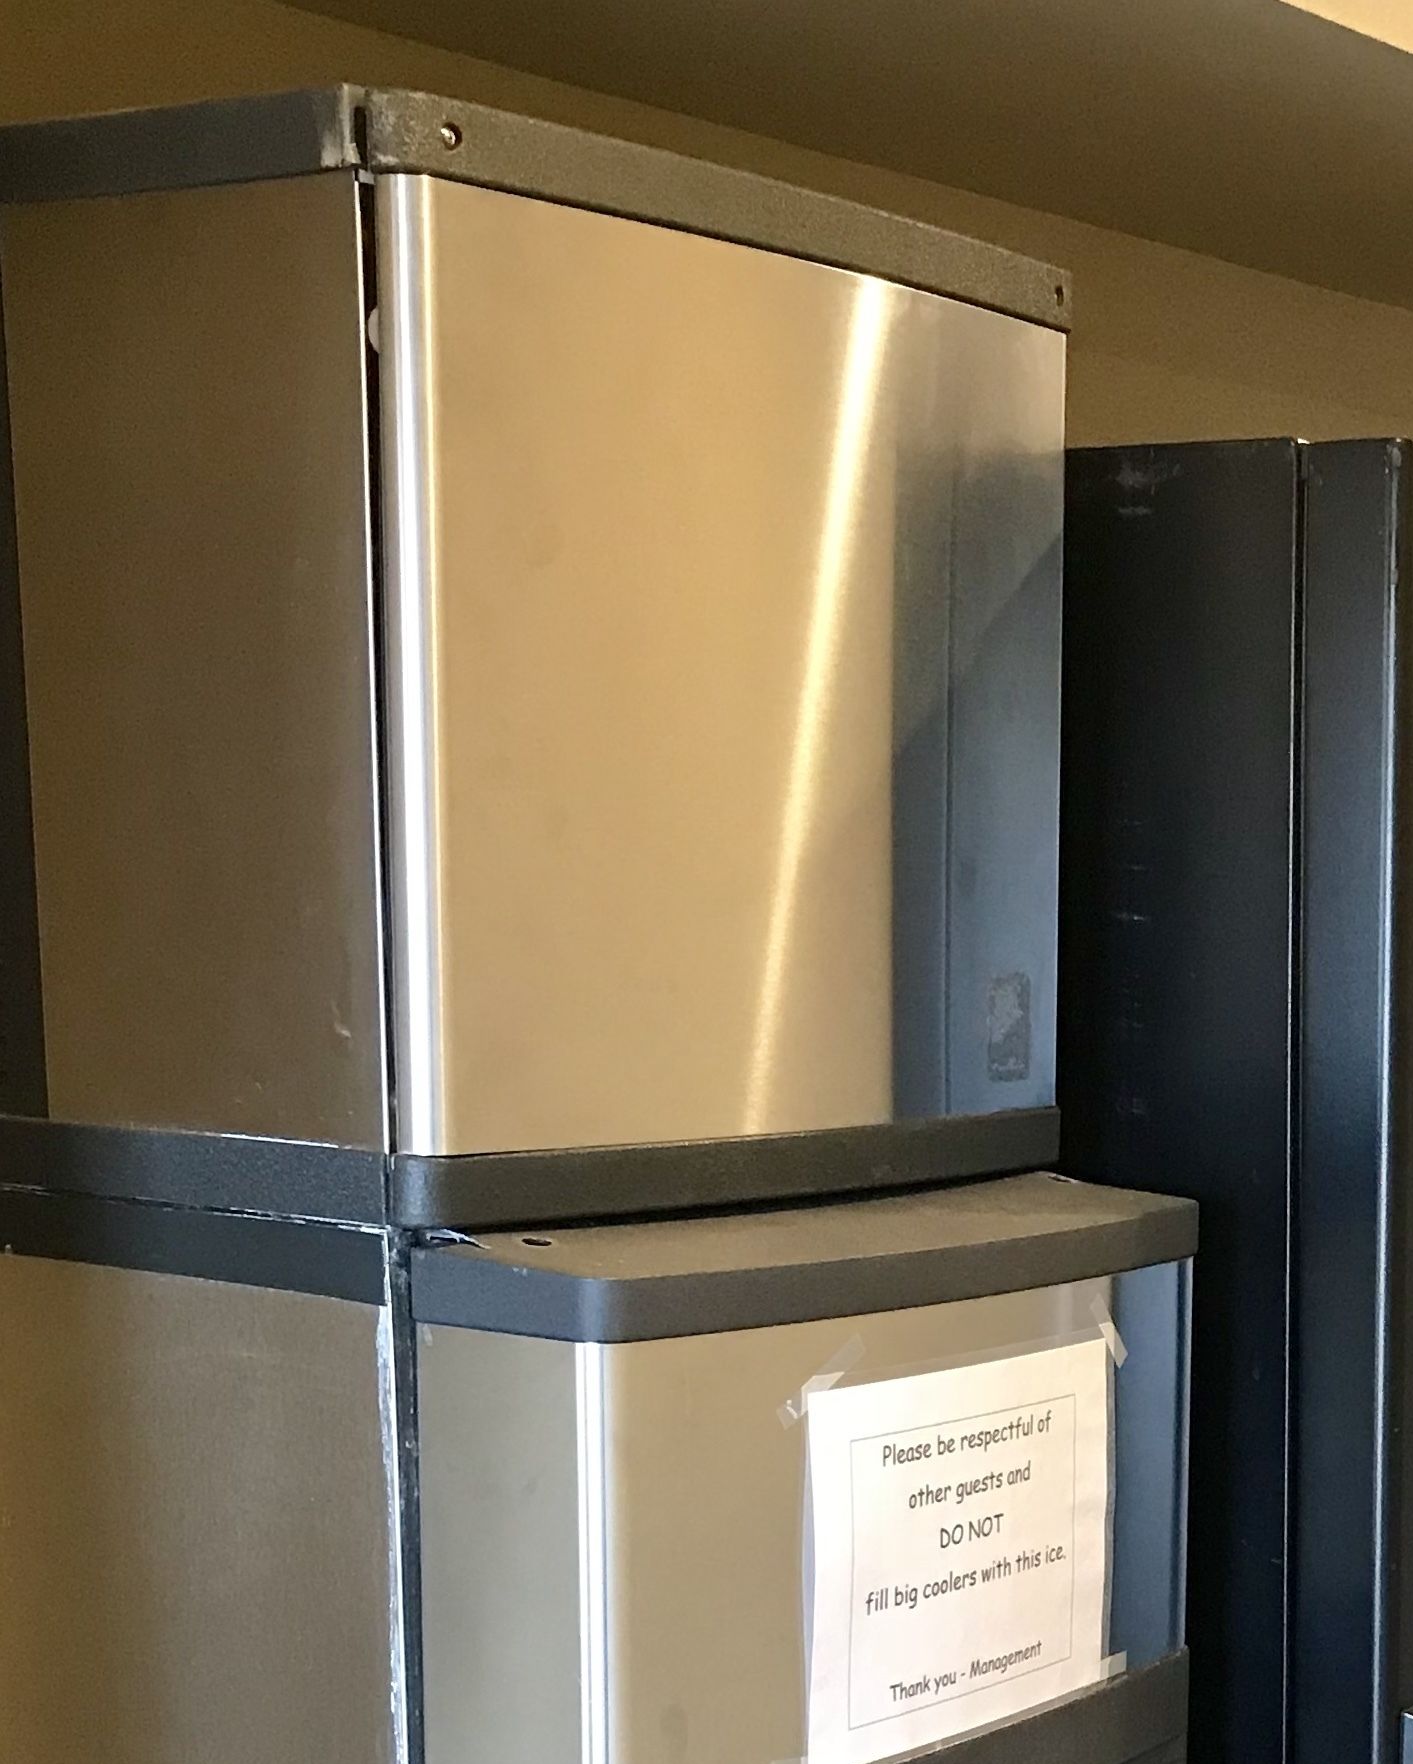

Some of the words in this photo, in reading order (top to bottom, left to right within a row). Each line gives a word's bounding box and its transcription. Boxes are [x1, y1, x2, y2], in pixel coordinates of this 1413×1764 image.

[883, 1443, 932, 1467] Please
[937, 1435, 956, 1455] be
[960, 1415, 1033, 1452] respectful
[1037, 1410, 1052, 1433] of
[909, 1484, 951, 1509] other
[956, 1472, 1003, 1504] guests
[1007, 1461, 1031, 1486] and
[940, 1524, 964, 1549] DO
[969, 1513, 1004, 1541] NOT
[865, 1588, 888, 1616] fill
[894, 1584, 918, 1609] big
[923, 1570, 977, 1599] coolers
[981, 1558, 1011, 1583] with
[1015, 1550, 1041, 1573] this
[1045, 1546, 1066, 1564] ice.
[889, 1675, 931, 1702] Thank
[934, 1672, 957, 1695] you
[969, 1640, 1042, 1679] Management
